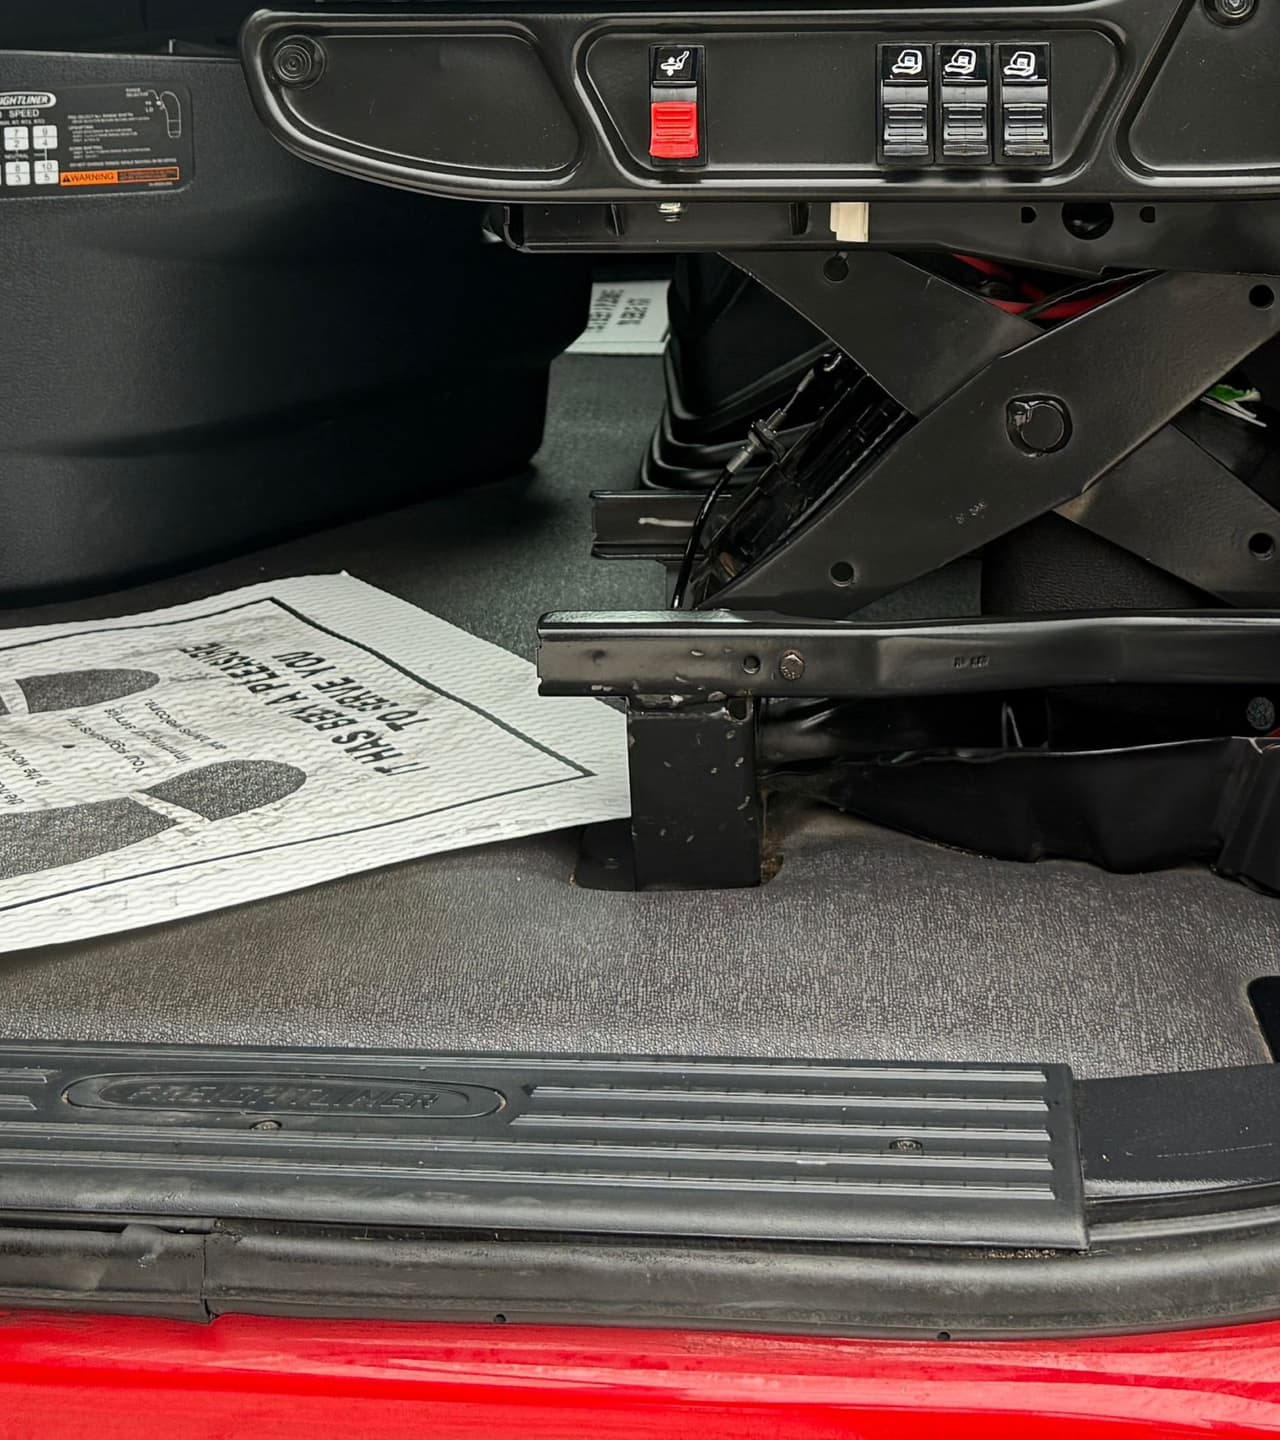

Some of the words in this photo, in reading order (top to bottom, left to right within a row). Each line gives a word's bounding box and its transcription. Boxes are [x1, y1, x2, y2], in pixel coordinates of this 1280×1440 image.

[9, 109, 39, 118] SPEED
[70, 172, 114, 183] WARNING
[177, 641, 291, 695] PLEASURE
[271, 650, 337, 680] YOU
[263, 689, 309, 707] A
[311, 677, 400, 712] SERVE
[278, 702, 359, 733] BEEN
[375, 709, 431, 732] TO
[331, 730, 404, 765] HAS
[373, 762, 431, 777] IT
